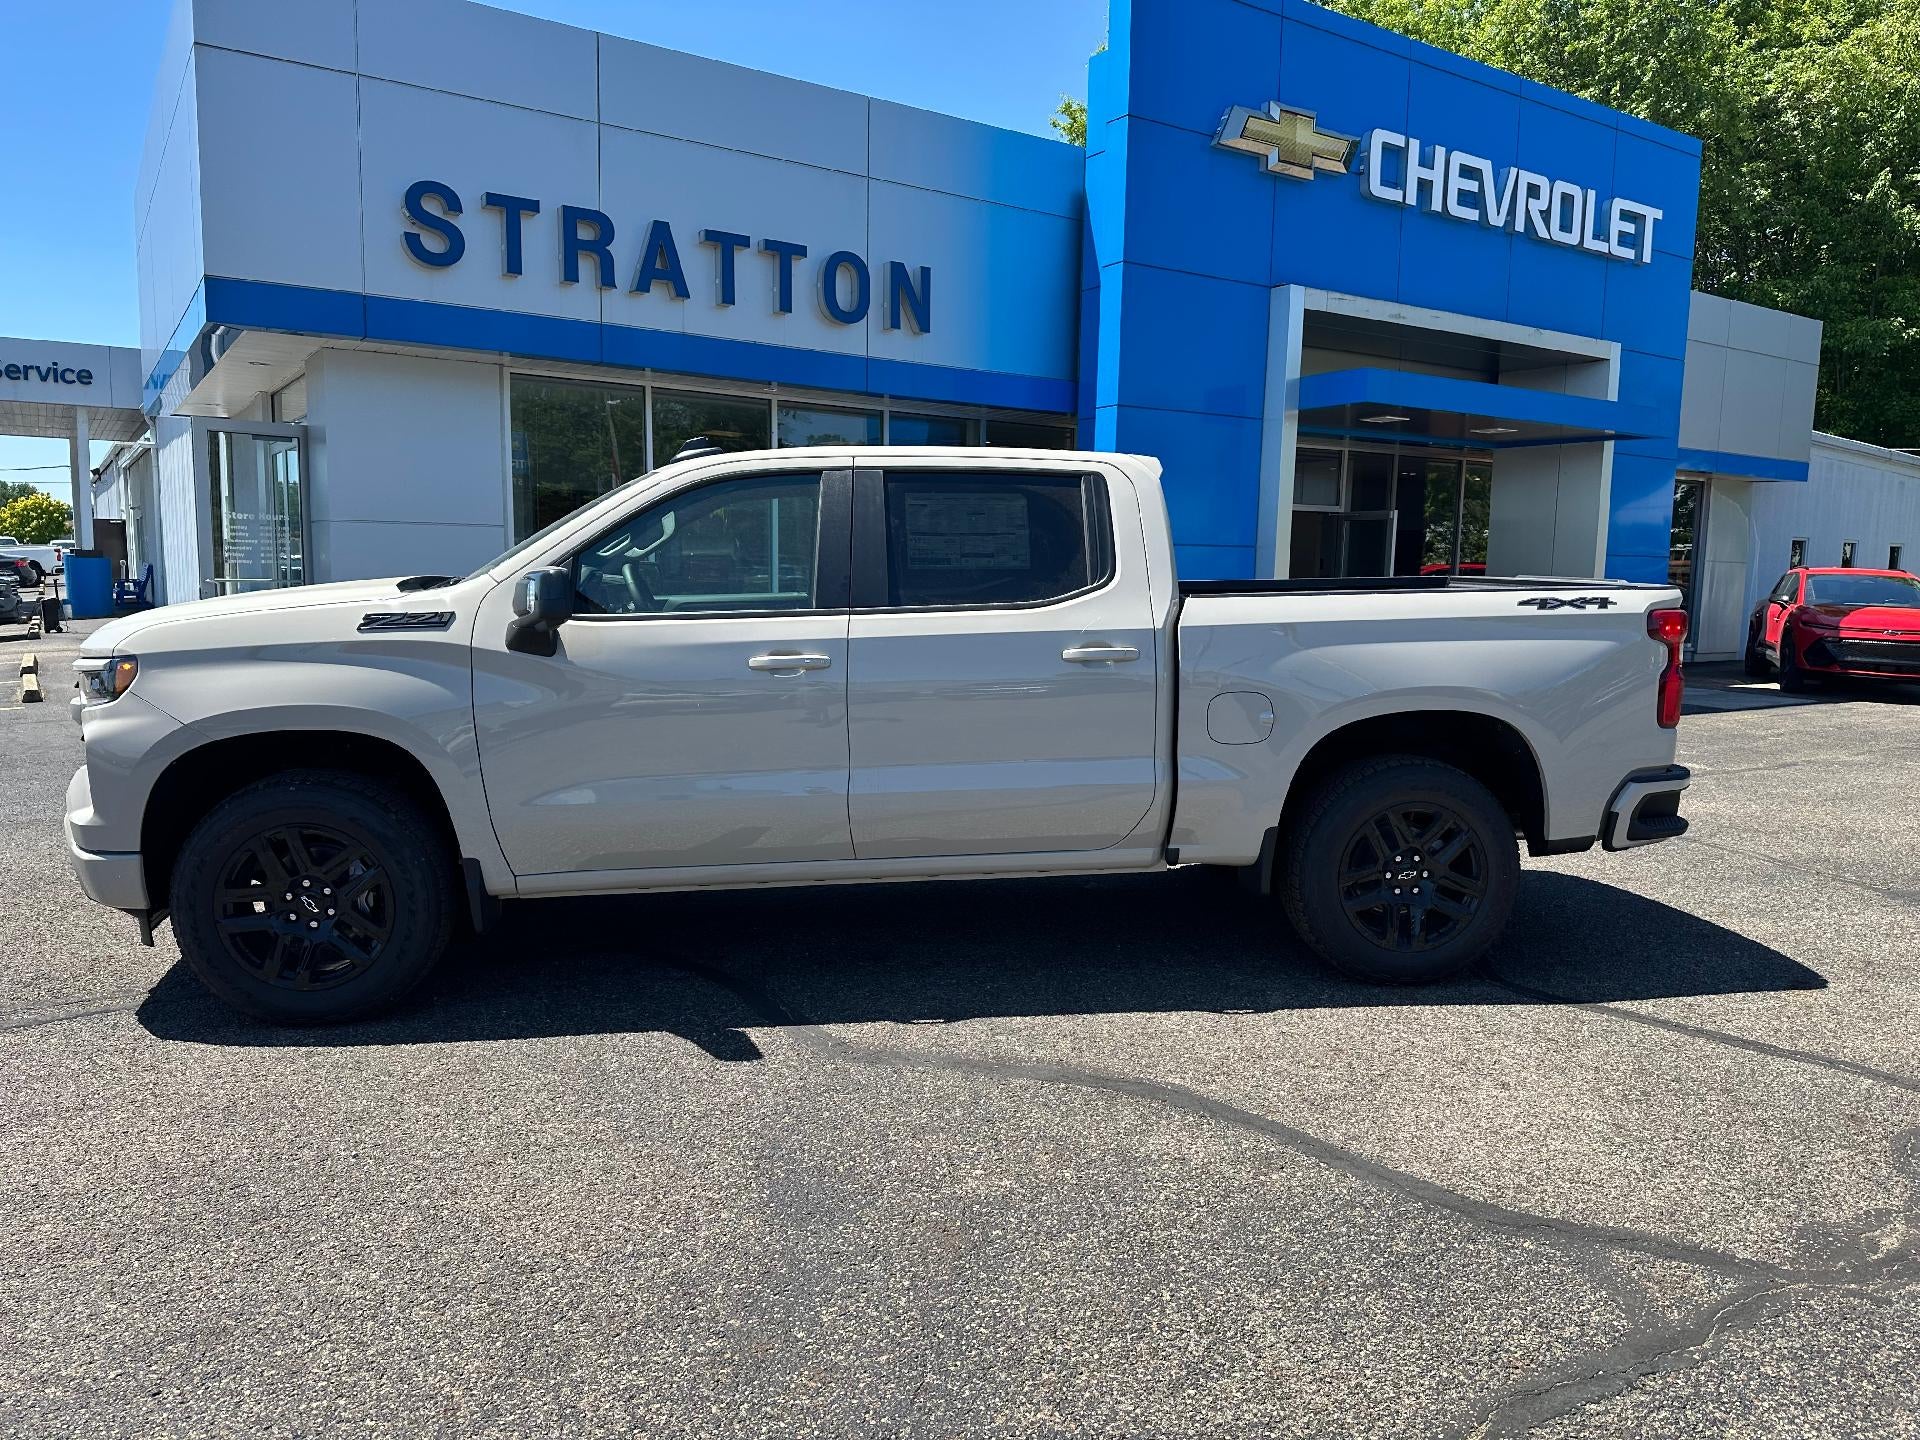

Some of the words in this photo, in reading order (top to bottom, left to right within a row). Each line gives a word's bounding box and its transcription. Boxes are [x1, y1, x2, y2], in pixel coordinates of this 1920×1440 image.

[1362, 127, 1663, 265] CHEVROLET
[401, 179, 932, 335] STRATTON
[0, 361, 93, 385] ervice
[356, 611, 456, 633] Z71
